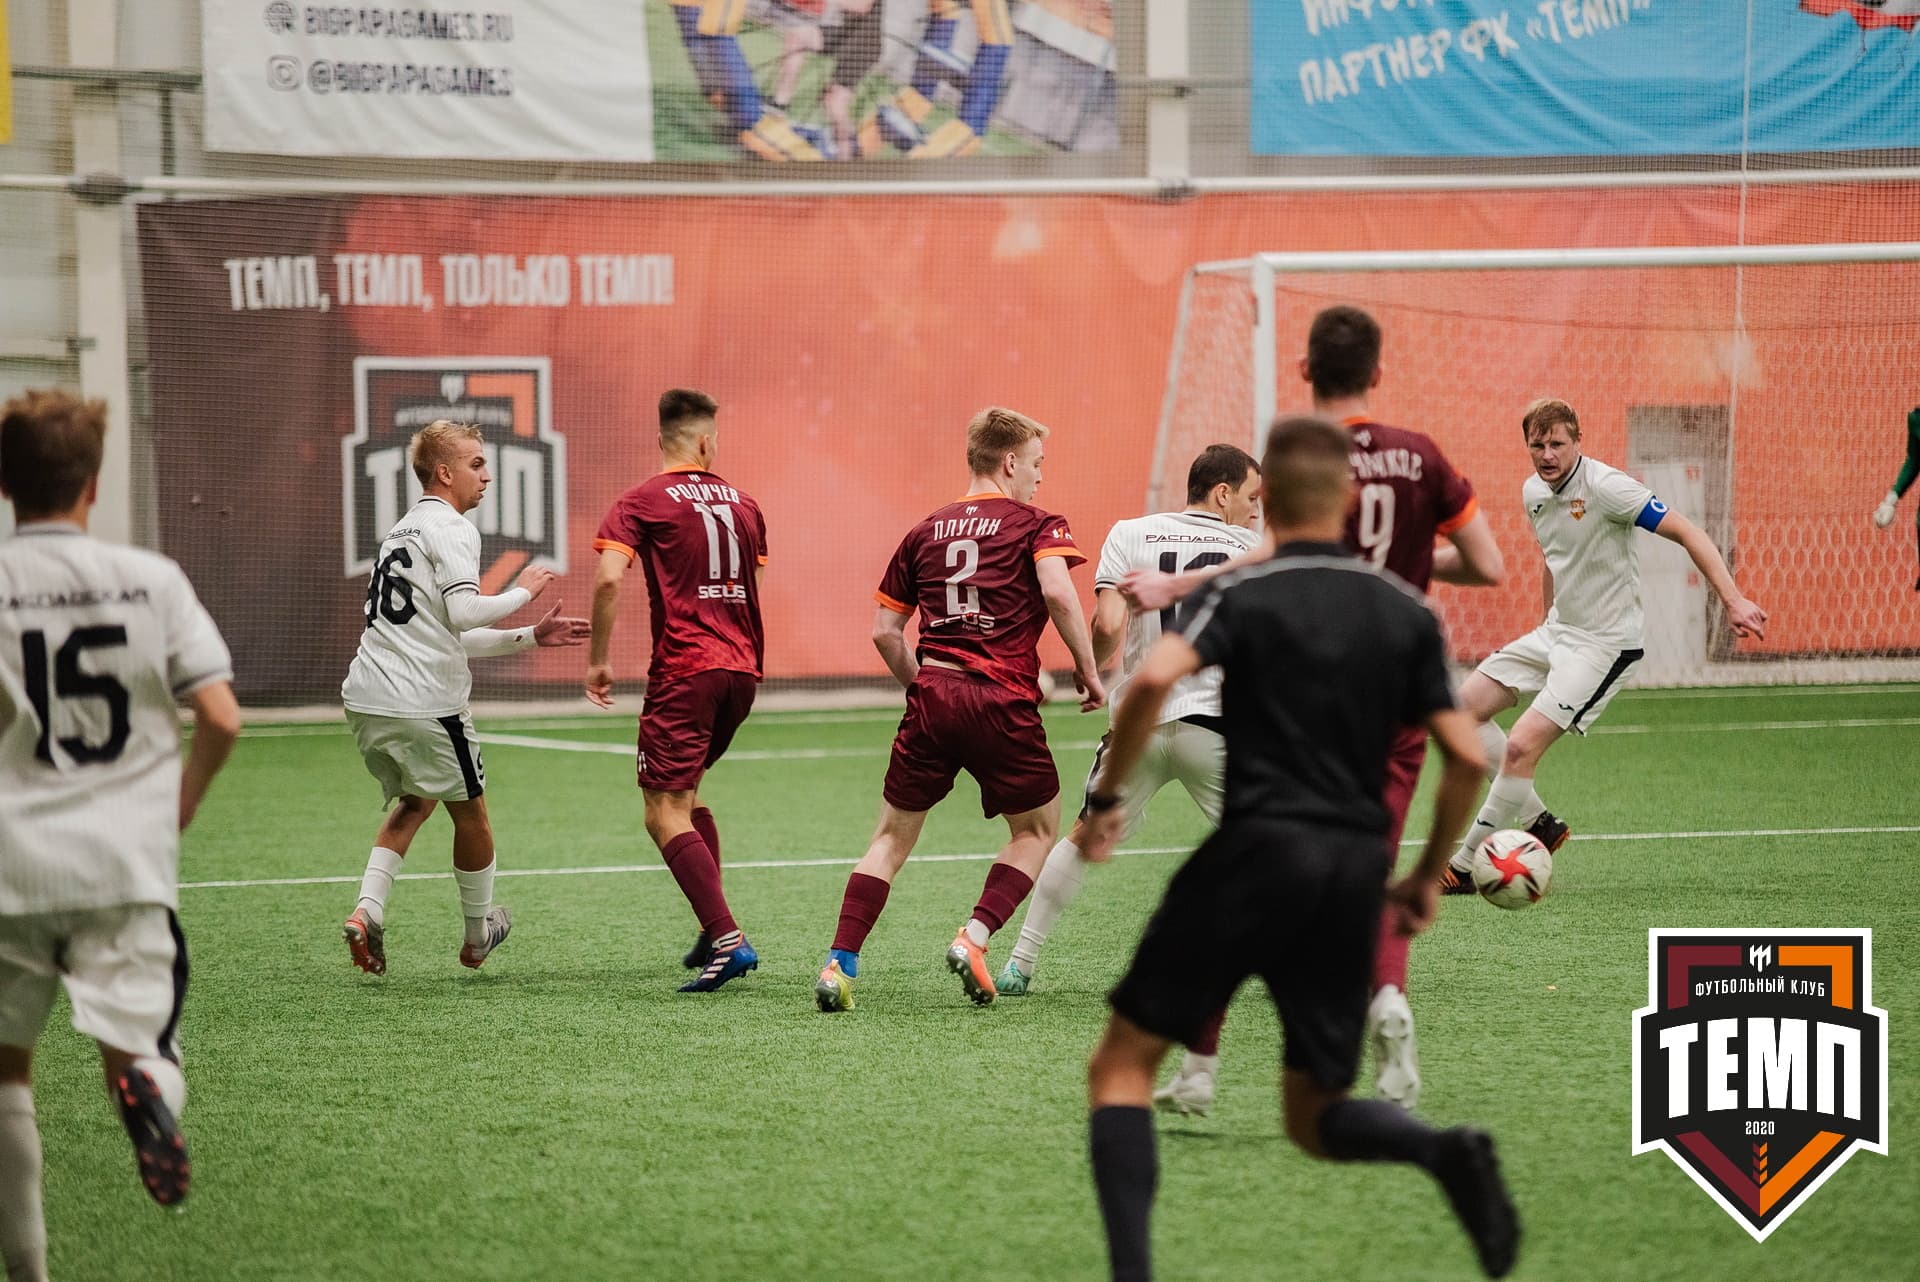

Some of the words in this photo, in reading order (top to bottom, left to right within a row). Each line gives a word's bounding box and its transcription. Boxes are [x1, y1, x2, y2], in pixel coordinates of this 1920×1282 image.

[1299, 27, 1452, 106] ПАРТНЕР
[1459, 10, 1520, 62] ФК
[223, 255, 331, 313] ТЕМП,
[333, 253, 434, 313] ТЕМП,
[440, 253, 571, 308] ТОЛЬКО
[576, 253, 675, 306] ТЕМП!
[664, 483, 741, 505] РОДИЧЕВ
[933, 517, 1002, 541] ПЛУГИН
[1359, 483, 1396, 575] 9
[692, 503, 741, 580] 11
[944, 539, 980, 616] 2
[21, 624, 131, 770] 15
